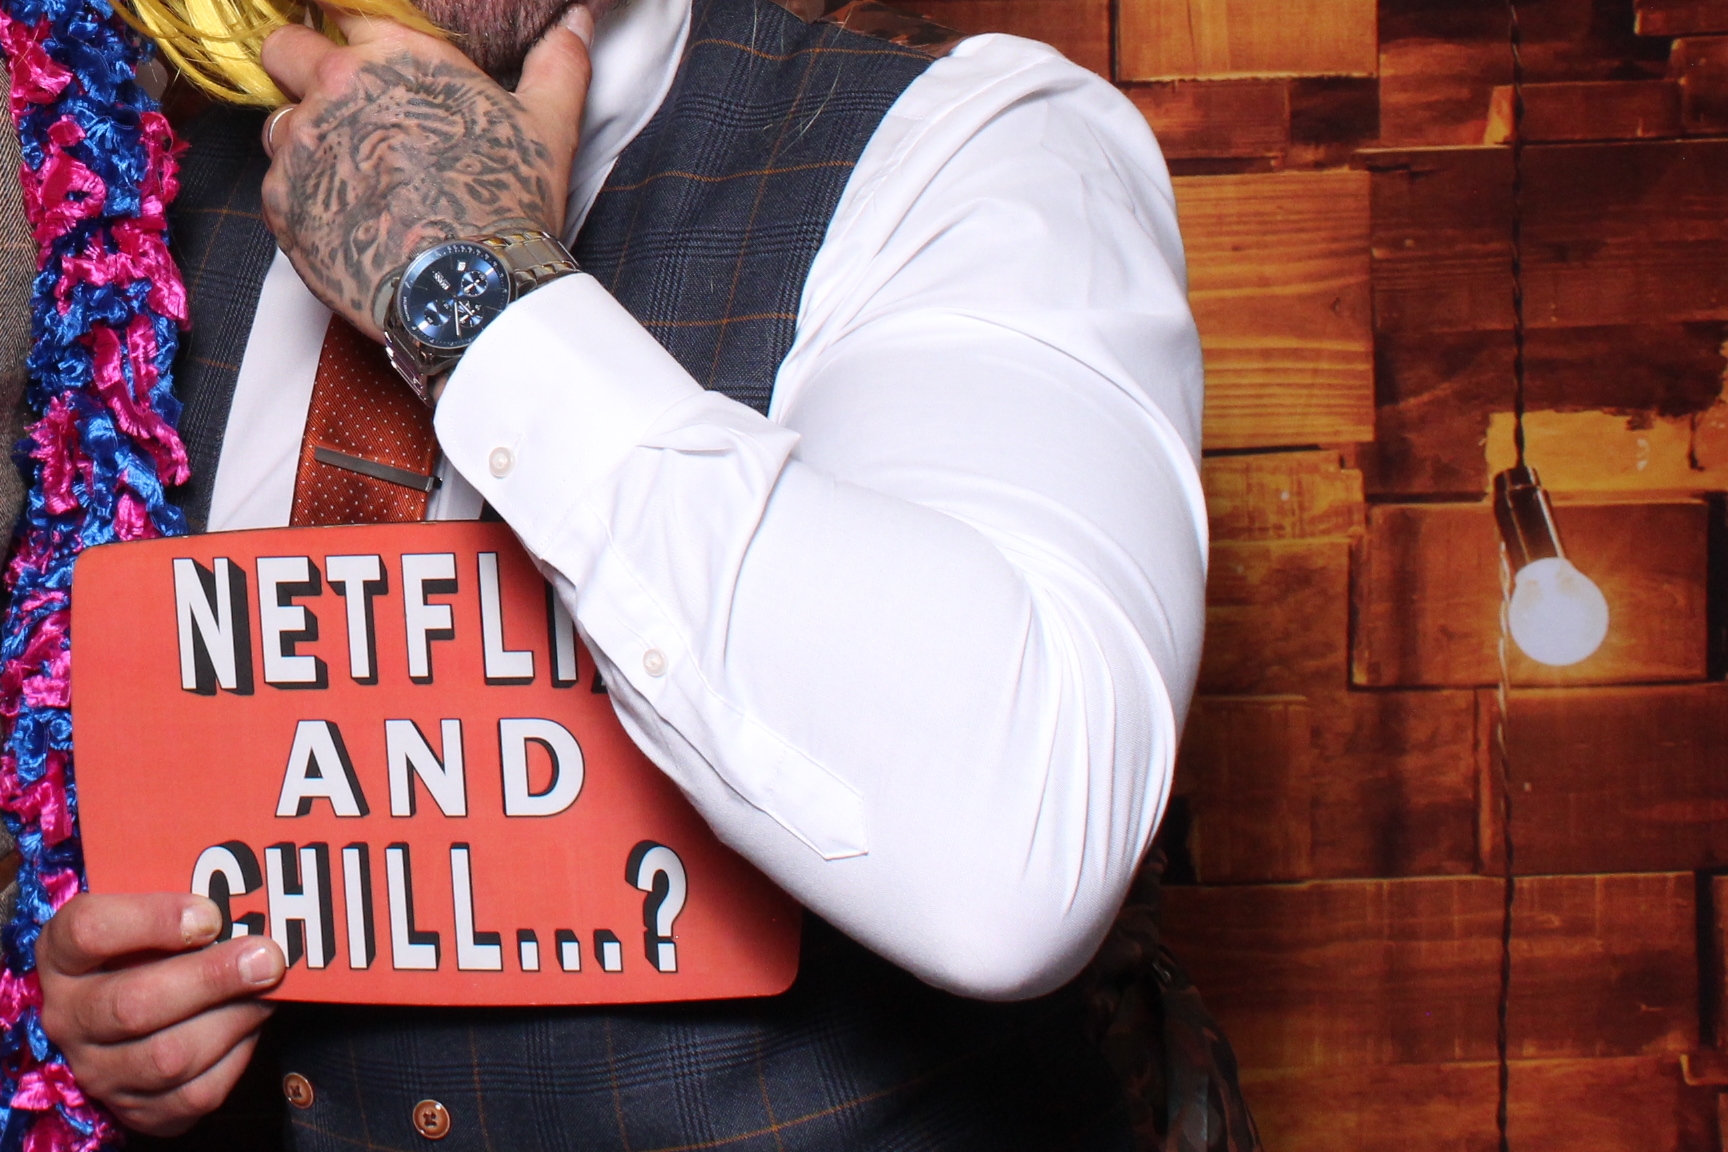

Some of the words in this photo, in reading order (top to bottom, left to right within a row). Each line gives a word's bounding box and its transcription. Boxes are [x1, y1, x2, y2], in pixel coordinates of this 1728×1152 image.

[172, 551, 610, 695] NETFLI
[275, 717, 586, 818] AND
[190, 839, 689, 973] CHILL...?
